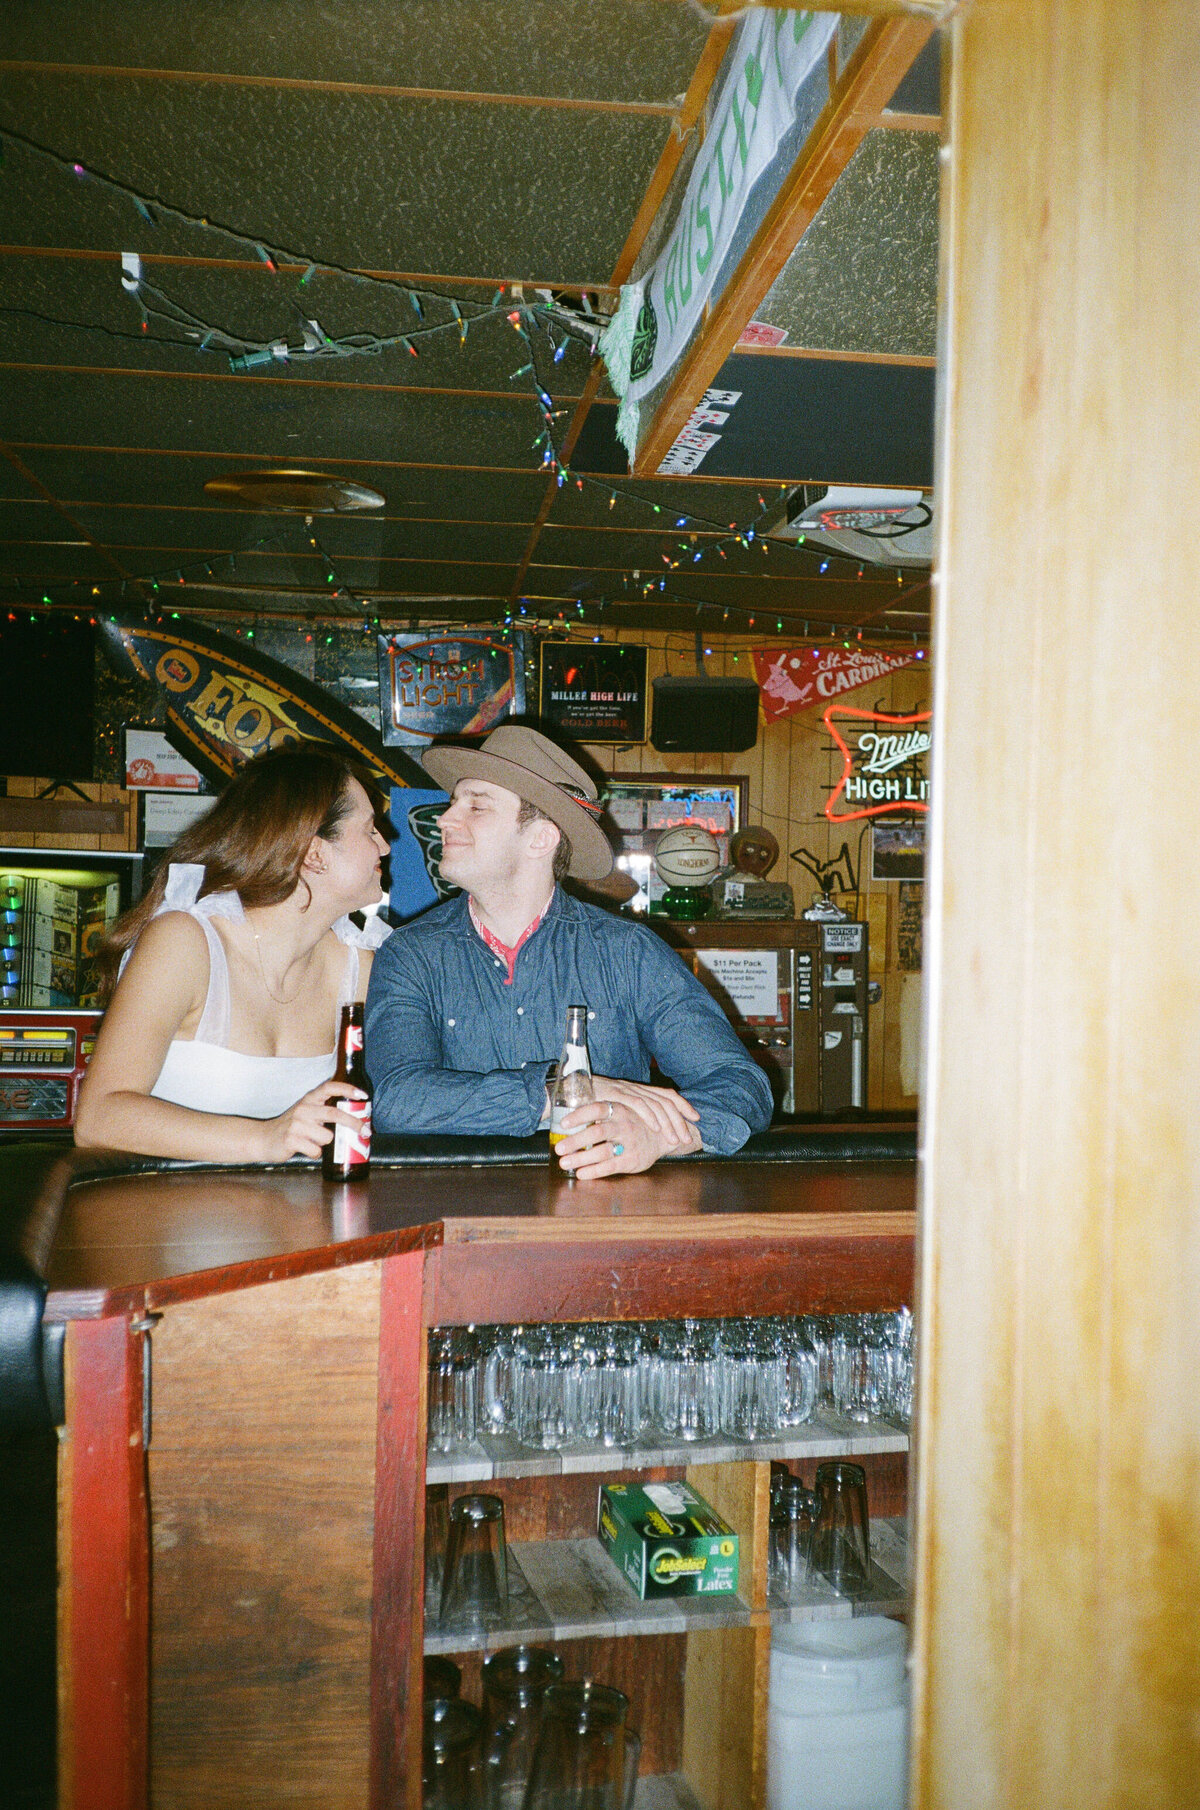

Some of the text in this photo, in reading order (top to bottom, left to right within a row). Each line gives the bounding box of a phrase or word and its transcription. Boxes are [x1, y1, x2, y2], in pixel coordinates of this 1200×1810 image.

[663, 22, 766, 334] AUSTIN
[398, 659, 485, 683] STROH
[812, 651, 884, 675] St. Louis
[401, 684, 479, 707] LIGHT
[551, 691, 639, 702] MILLER HIGH LIFE
[561, 718, 628, 729] COLD BEER
[858, 730, 933, 766] Mille
[845, 776, 900, 800] HIGH
[713, 959, 727, 967] $11
[696, 1578, 733, 1592] Latex
